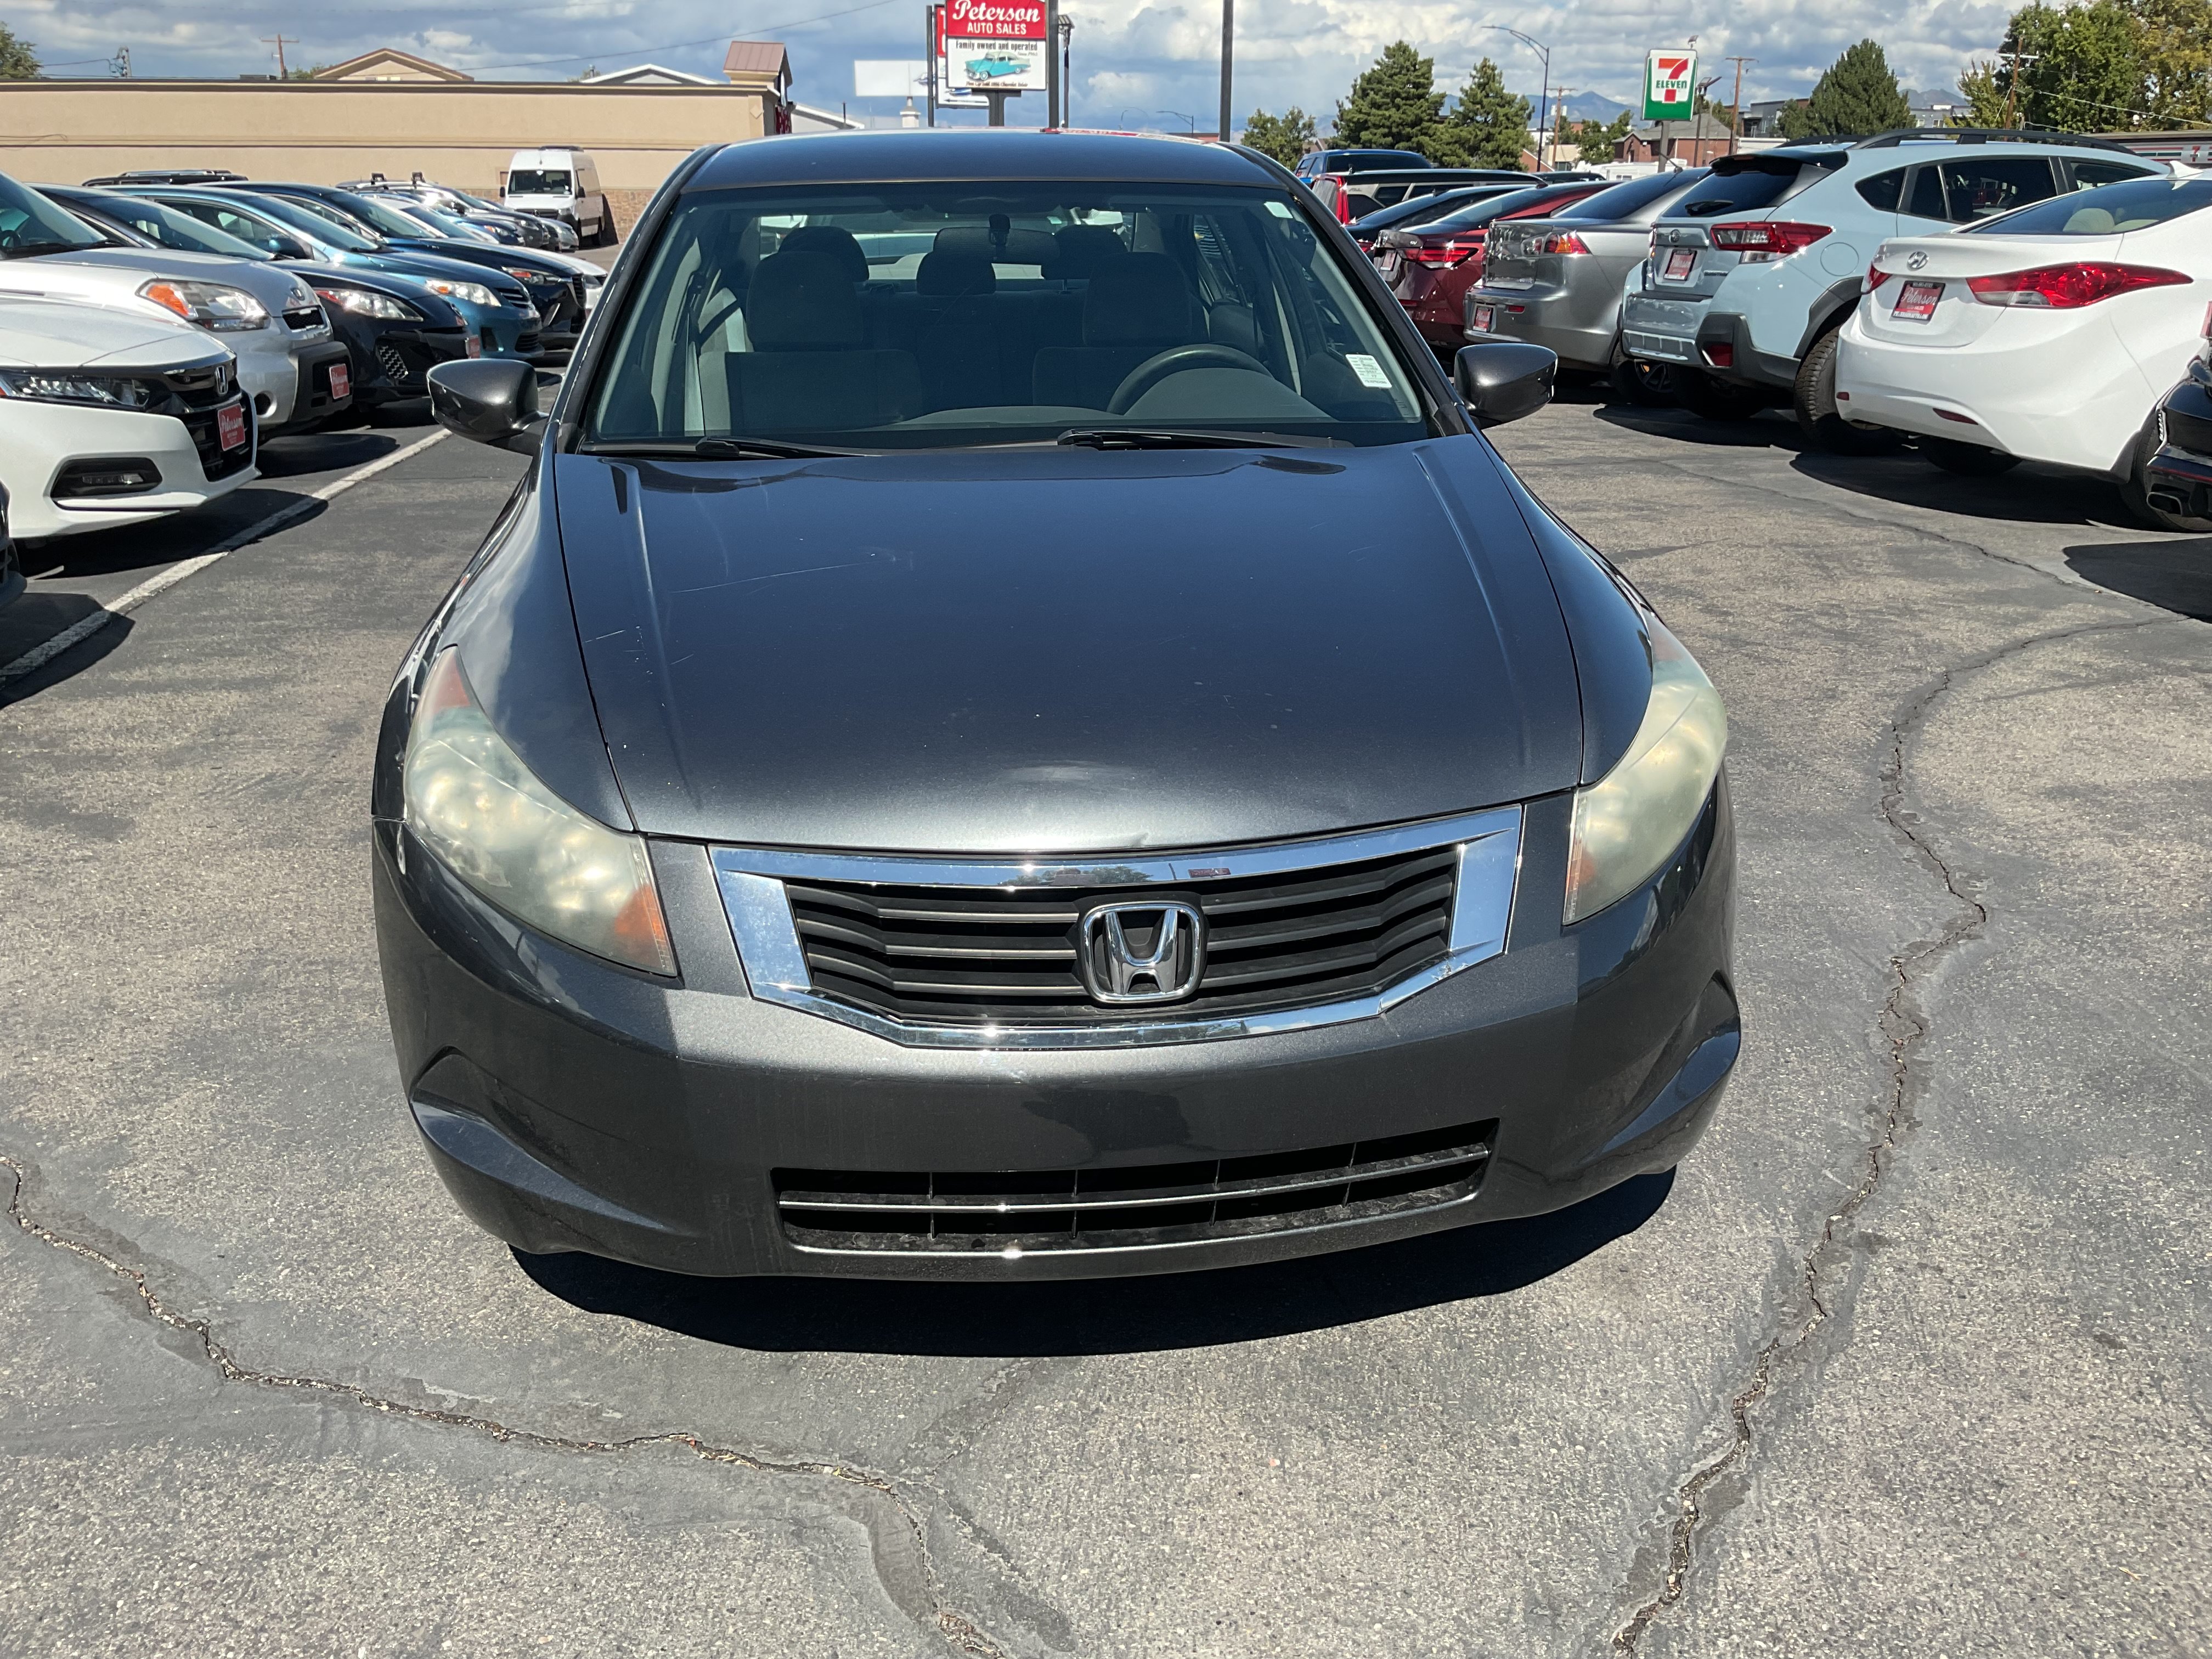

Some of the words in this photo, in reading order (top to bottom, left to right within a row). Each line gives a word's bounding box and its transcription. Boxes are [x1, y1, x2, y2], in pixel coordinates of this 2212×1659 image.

[952, 0, 1040, 22] Peterson
[967, 22, 993, 33] AUTO
[996, 23, 1026, 35] SALES
[956, 40, 975, 50] Family
[977, 41, 996, 50] owned
[998, 42, 1009, 50] and
[1011, 42, 1037, 52] operated
[1658, 58, 1689, 103] 7
[1900, 287, 1938, 305] Peterson
